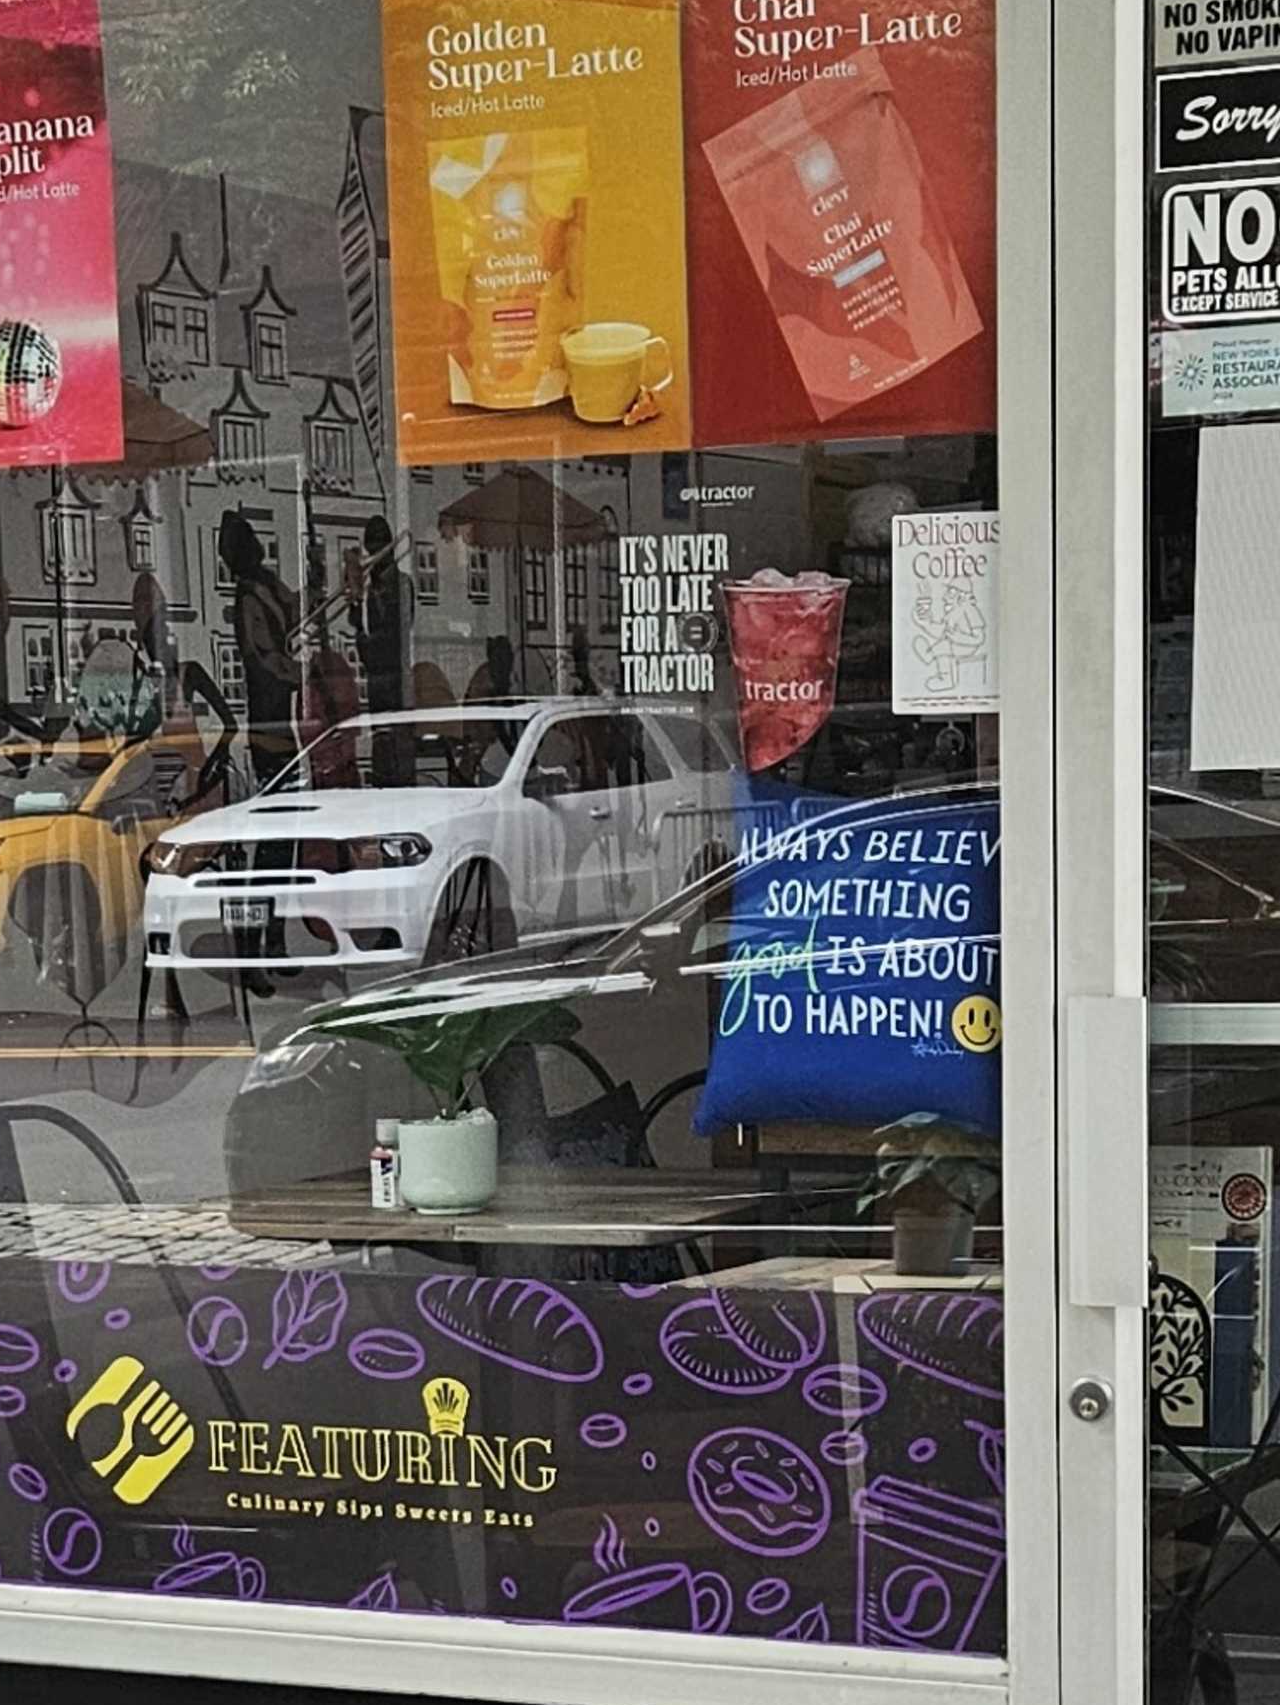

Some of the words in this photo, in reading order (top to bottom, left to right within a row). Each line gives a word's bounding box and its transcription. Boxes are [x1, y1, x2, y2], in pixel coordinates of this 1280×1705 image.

[1163, 2, 1197, 29] NO
[427, 19, 547, 59] Golden
[734, 9, 964, 61] Super-Latte
[1175, 29, 1209, 56] NO
[428, 44, 644, 95] Super-Latte
[735, 63, 809, 88] Iced/Hot
[813, 58, 859, 80] Latte
[430, 96, 500, 119] Iced/Hot
[502, 93, 547, 114] Latte
[42, 181, 81, 199] Latte
[822, 211, 863, 245] Chai
[1172, 188, 1277, 268] NO
[486, 253, 539, 271] Golden
[1171, 267, 1228, 295] PETS
[1171, 293, 1222, 314] EXCEPT
[1224, 289, 1280, 311] SERVICE
[1212, 350, 1239, 361] NEW
[1241, 348, 1273, 360] YORK
[896, 515, 999, 548] Delicious
[619, 535, 658, 575] IT'S
[662, 533, 729, 573] NEVER
[911, 546, 988, 580] Coffee
[620, 576, 662, 615] TOO
[666, 574, 714, 613] LATE
[621, 615, 660, 653] FOR
[664, 615, 679, 653] A
[621, 653, 715, 694] TRACTOR
[744, 678, 824, 703] tractor
[737, 827, 854, 867] ALWAYS
[763, 878, 971, 922] SOMETHING
[720, 908, 821, 1037] good
[826, 935, 867, 976] IS
[878, 936, 999, 986] ABOUT
[754, 994, 793, 1034] TO
[805, 994, 944, 1040] HAPPEN!
[207, 1419, 558, 1494] FEATURING
[225, 1492, 326, 1518] Culinary
[336, 1498, 384, 1520] Sips
[395, 1502, 473, 1524] Sweets
[483, 1508, 535, 1528] Eats
